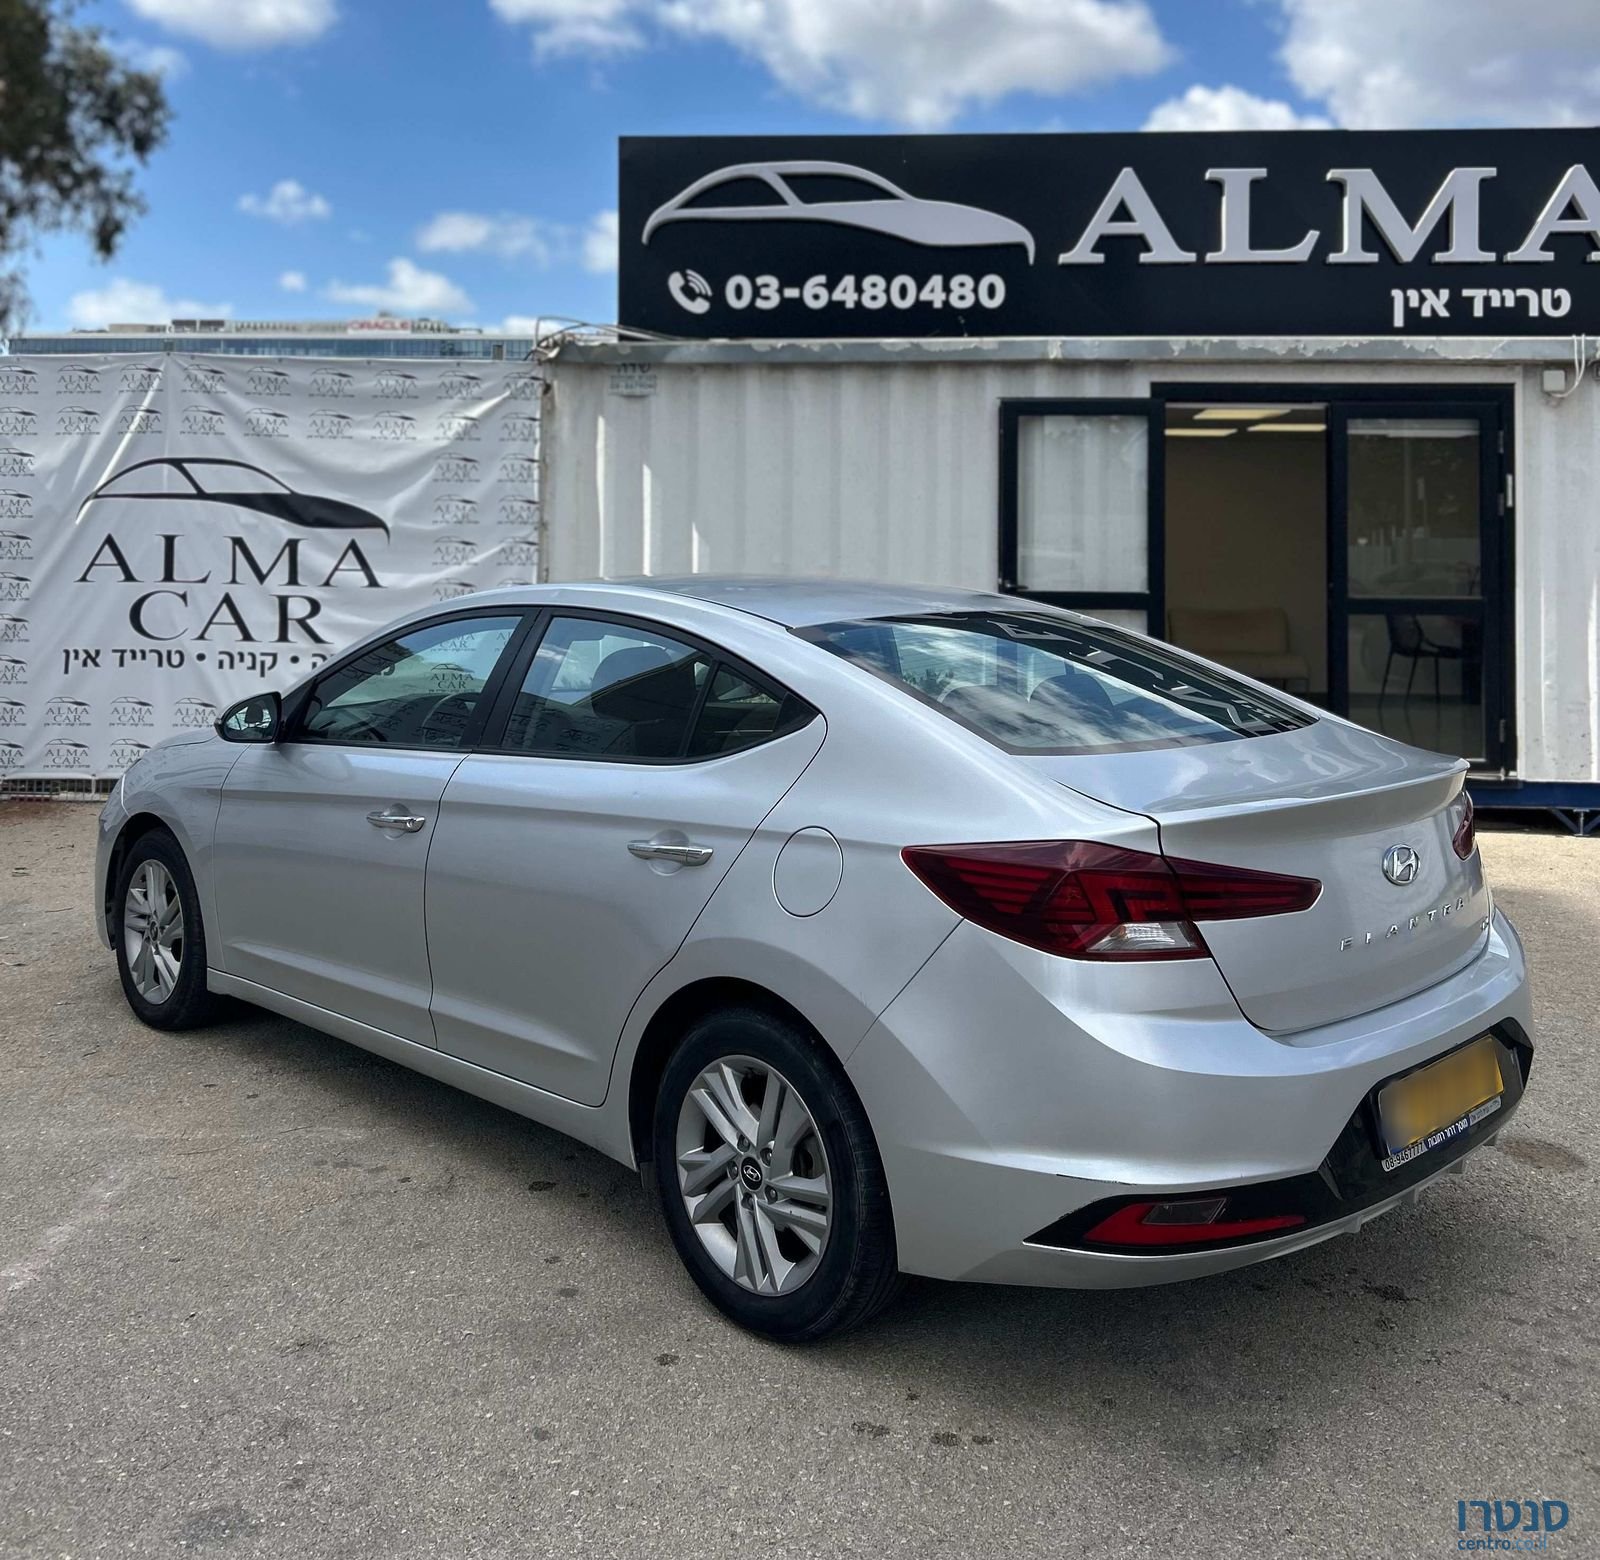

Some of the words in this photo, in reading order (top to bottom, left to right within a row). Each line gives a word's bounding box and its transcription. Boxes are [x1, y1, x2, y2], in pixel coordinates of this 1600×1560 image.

[1058, 164, 1600, 264] ALMA
[725, 274, 1006, 309] 03-6480480
[1391, 288, 1450, 328] אין
[1461, 288, 1571, 318] טרייד
[73, 533, 388, 588] ALMA
[129, 590, 334, 645] CAR
[63, 648, 100, 674] אין
[112, 648, 185, 668] טרייד
[218, 650, 278, 678] קניה
